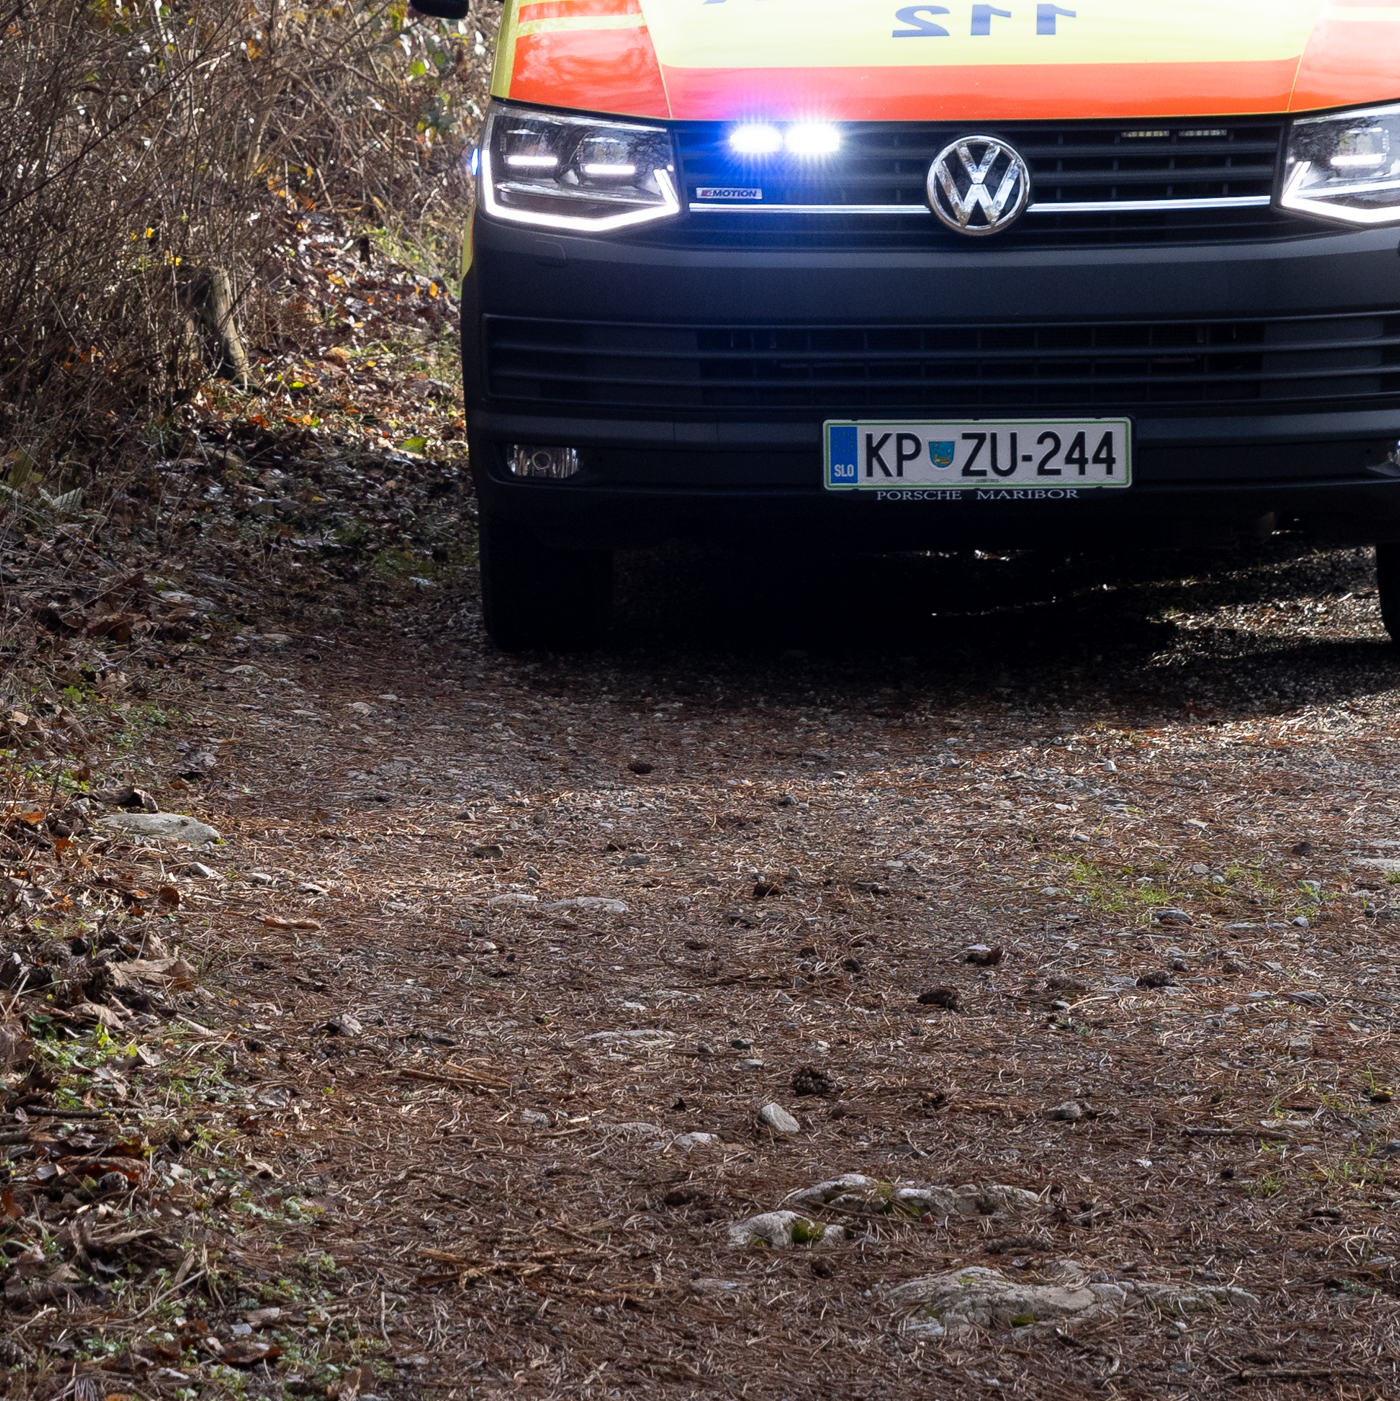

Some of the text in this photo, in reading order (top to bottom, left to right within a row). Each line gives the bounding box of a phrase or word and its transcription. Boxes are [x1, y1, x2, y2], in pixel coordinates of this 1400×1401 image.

[865, 430, 1117, 478] KP ZU-244
[833, 464, 855, 478] SLO
[875, 488, 1080, 501] PORSCHE MARIBOR
